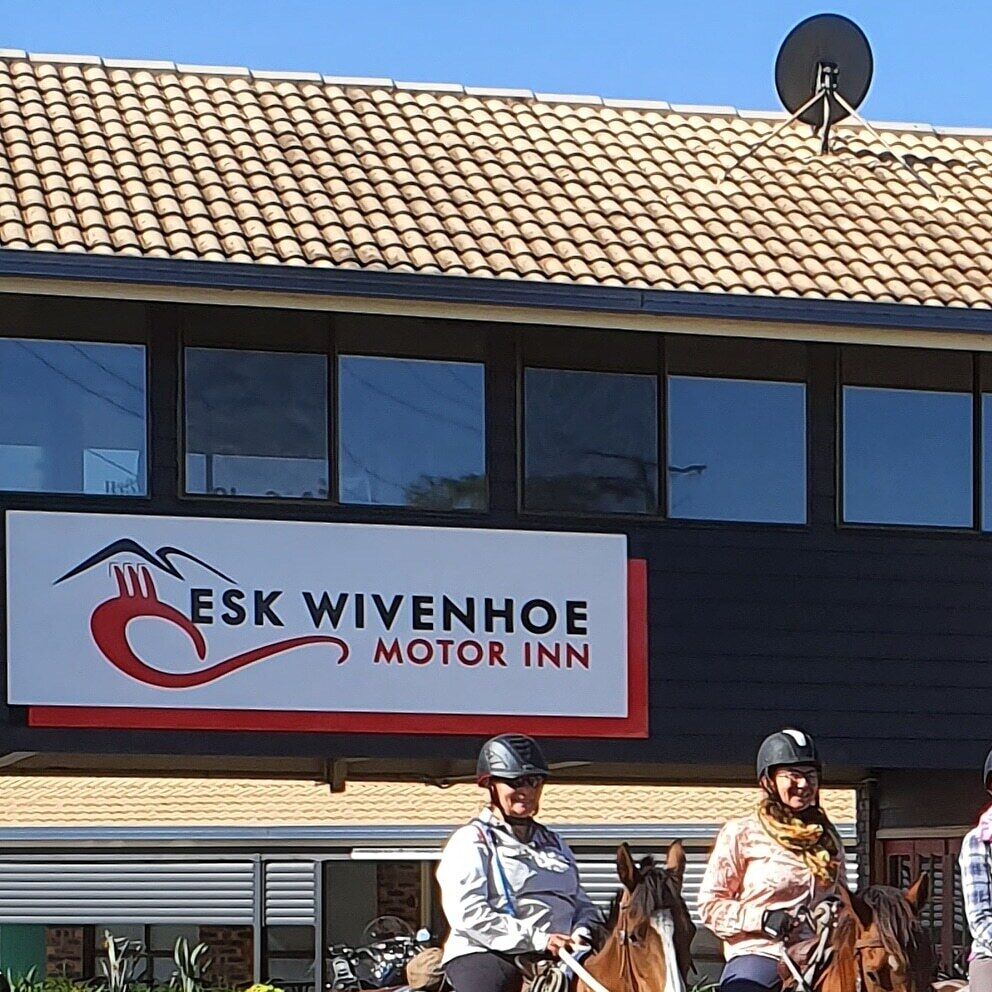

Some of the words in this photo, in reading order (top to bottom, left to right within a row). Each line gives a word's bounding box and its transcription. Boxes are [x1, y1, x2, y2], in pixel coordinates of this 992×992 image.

[190, 588, 284, 626] ESK
[302, 592, 589, 635] WIVENHOE
[374, 637, 507, 667] MOTOR
[525, 642, 590, 668] INN
